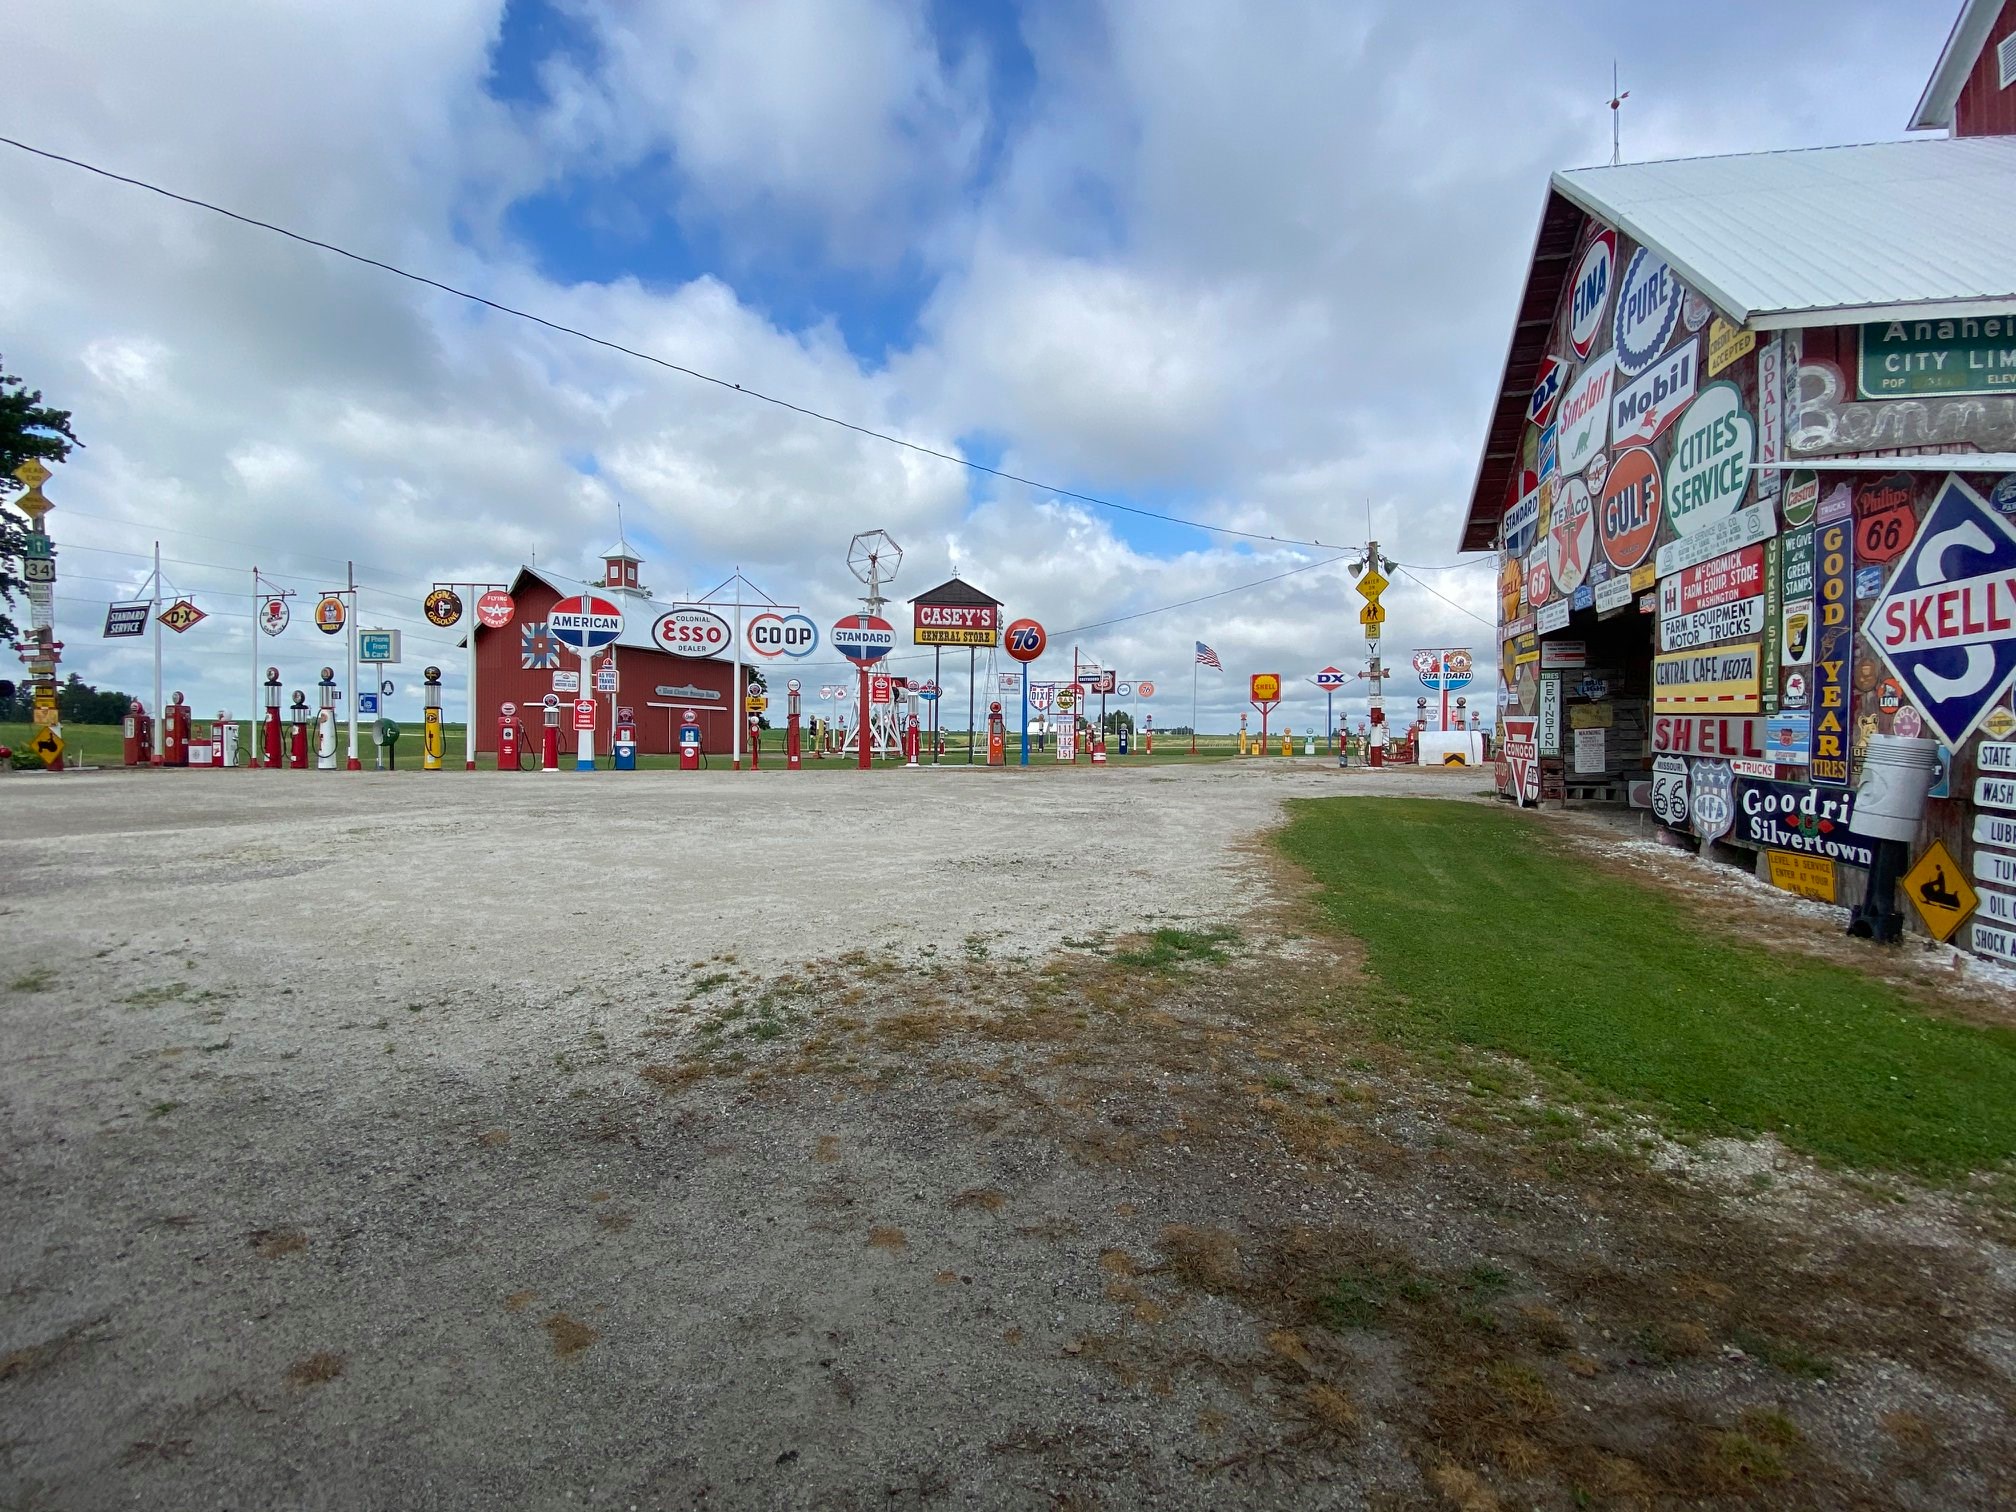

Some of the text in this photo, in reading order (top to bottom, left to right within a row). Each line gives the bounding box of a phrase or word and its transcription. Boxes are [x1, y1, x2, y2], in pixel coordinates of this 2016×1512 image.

[1573, 255, 1607, 331] FINA
[1627, 263, 1669, 334] PURE
[1883, 316, 2016, 342] Anahei
[1712, 336, 1751, 369] ACCEPTED
[1885, 349, 2016, 372] CITY LIM
[1532, 363, 1559, 416] DX
[1618, 353, 1690, 429] Mobil
[1882, 379, 1906, 388] POP
[1560, 367, 1611, 435] Sinclair
[1679, 409, 1738, 473] CITIES
[1671, 451, 1744, 519] SERVICE
[1605, 473, 1655, 541] GULF
[1787, 486, 1816, 507] Castrol
[1862, 486, 1908, 513] Phillips
[1505, 495, 1538, 532] STANDARD
[1553, 496, 1589, 527] TEXACO
[1821, 501, 1846, 514] TRUCKS
[1785, 533, 1812, 551] WE GIVE
[1866, 518, 1902, 551] 66
[29, 563, 50, 576] 34
[1695, 552, 1742, 582] McCORMICK
[1787, 563, 1811, 580] GREEN
[1531, 568, 1546, 598] 66
[1684, 563, 1759, 600] FARM EQUIP. STORE
[1785, 577, 1813, 595] STAMPS
[1696, 588, 1739, 609] WASHINGTON
[1785, 604, 1810, 614] WELCOME
[110, 611, 146, 622] STANDARD
[427, 611, 460, 626] GASOLINE
[484, 616, 507, 625] SERVICE
[553, 616, 618, 629] AMERICAN
[676, 615, 710, 623] COLONIAL
[921, 607, 991, 626] CASEY'S
[1665, 600, 1754, 636] FARM EQUIPMENT
[1766, 539, 1777, 689] QUAKER STATE
[110, 622, 140, 633] SERVICE
[755, 626, 812, 645] COOP
[836, 631, 891, 643] STANDARD
[922, 630, 990, 643] GENERAL STORE
[1669, 618, 1751, 649] MOTOR TRUCKS
[1011, 627, 1040, 650] 76
[1317, 674, 1345, 683] DX
[1422, 672, 1472, 680] STADARD
[1541, 672, 1559, 680] TIRES
[1655, 658, 1689, 685] CENTRAL
[1721, 657, 1752, 682] KEOTA
[1031, 692, 1053, 701] DIXIE
[1582, 685, 1606, 693] LIGHT
[1880, 696, 1899, 707] LION
[1545, 681, 1556, 747] REMINGTON
[1654, 718, 1763, 758] SHELL
[1507, 743, 1534, 758] CONOCO
[1981, 746, 2012, 767] STATE
[1495, 762, 1507, 776] STOP
[1657, 760, 1683, 771] MISSOURI
[1742, 761, 1773, 776] TRUCKS
[1814, 760, 1846, 778] TIRES
[1653, 777, 1685, 819] 66
[1982, 782, 2014, 804] WASH
[1742, 788, 1849, 824] Goodri
[1750, 816, 1872, 865] Silvertown
[1770, 855, 1790, 866] LEVEL
[1802, 860, 1831, 873] SERVICE
[1775, 868, 1795, 879] ENTER
[1811, 874, 1829, 886] YOUR
[1990, 895, 2008, 917] OIL
[1975, 928, 2007, 955] SHOCK
